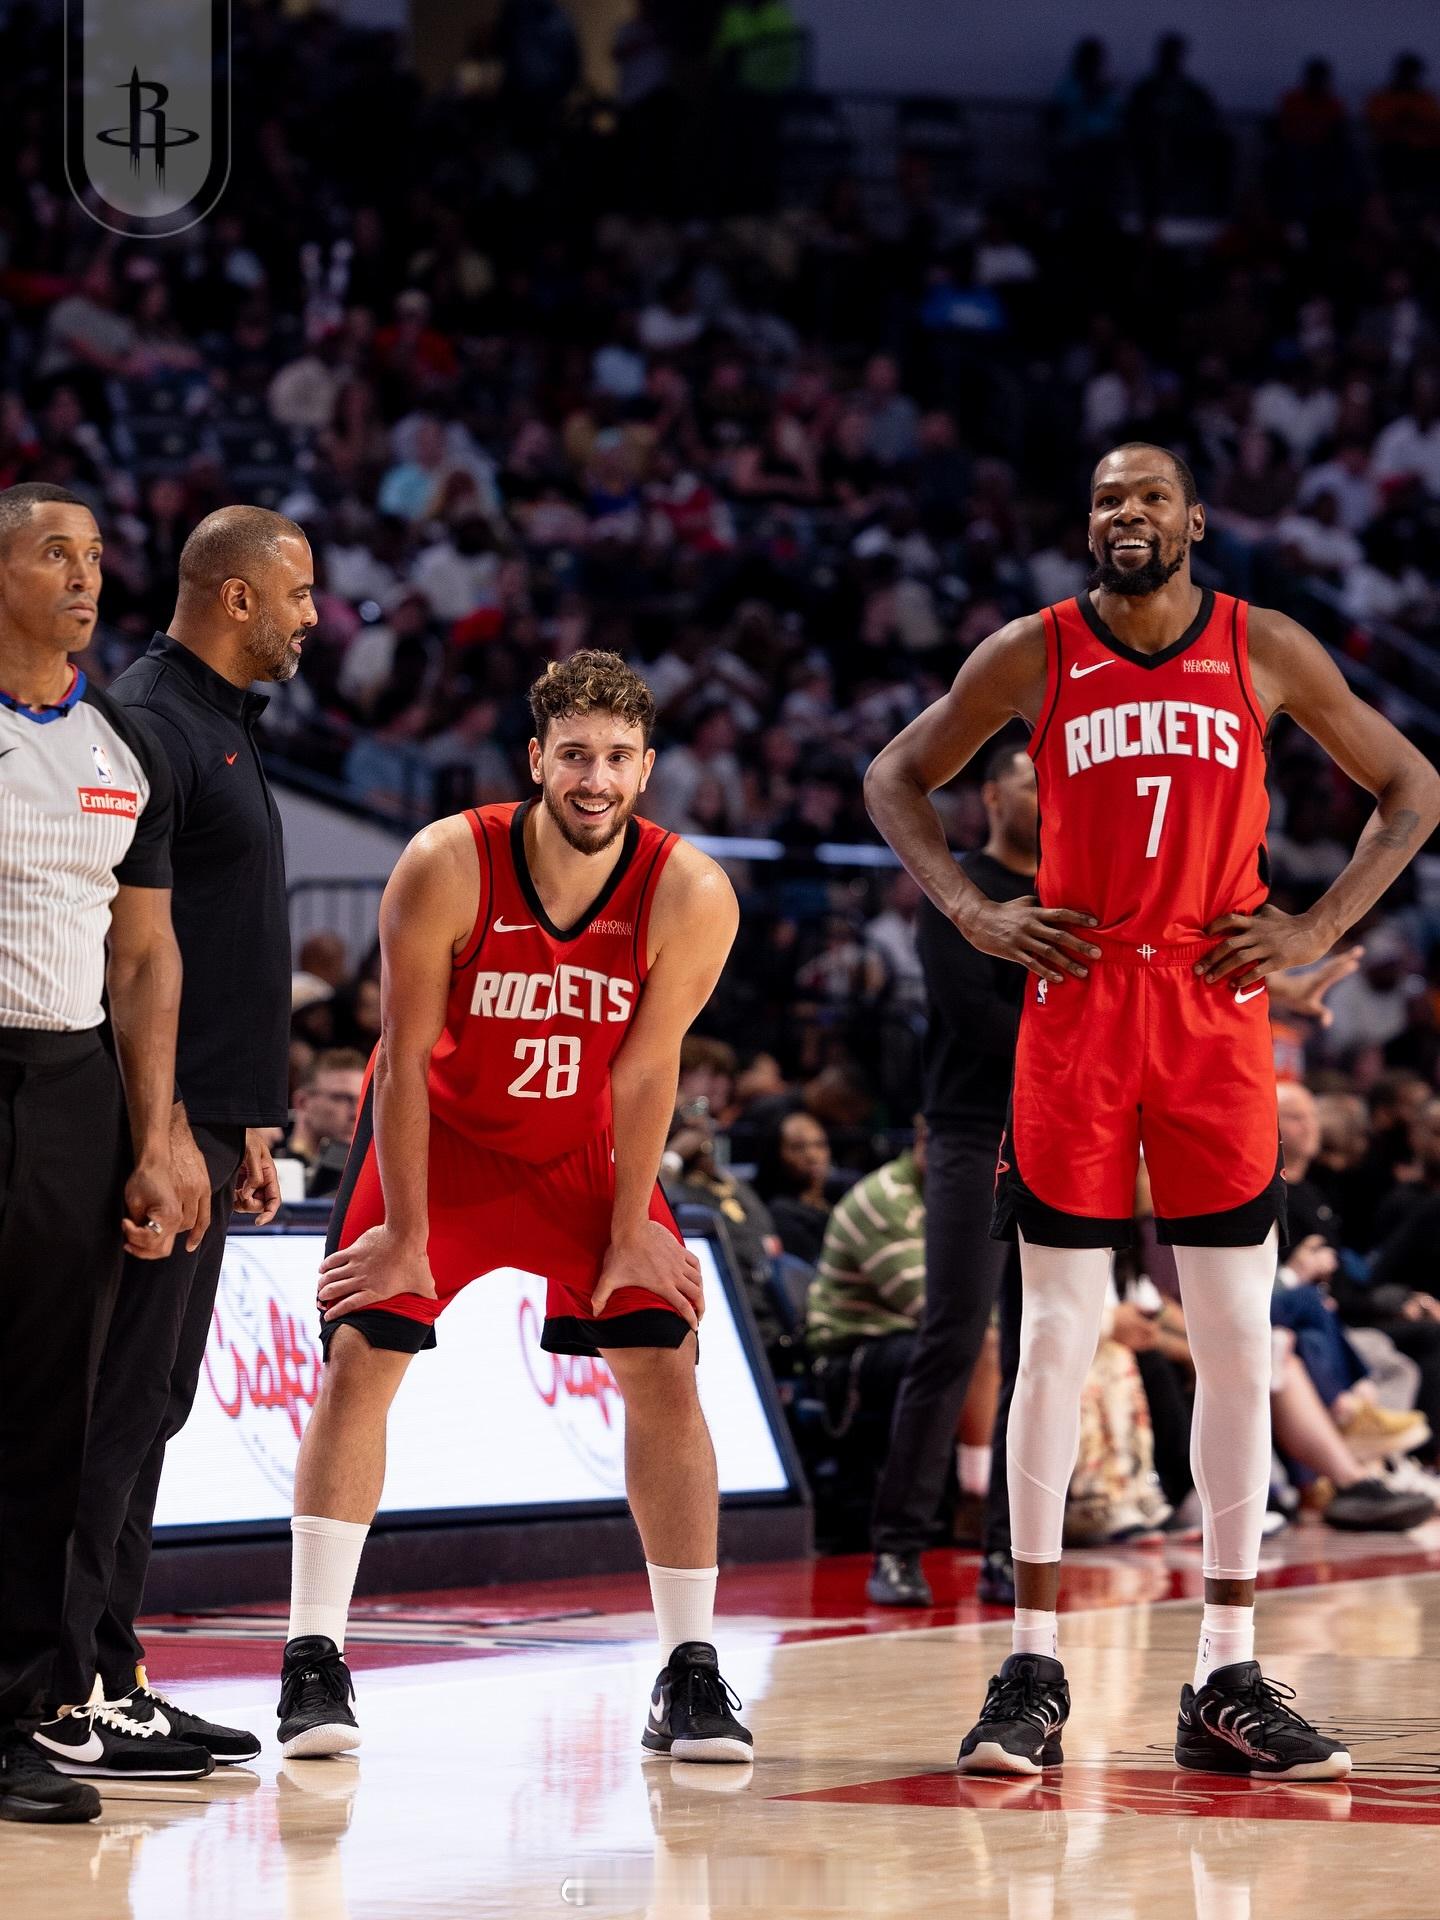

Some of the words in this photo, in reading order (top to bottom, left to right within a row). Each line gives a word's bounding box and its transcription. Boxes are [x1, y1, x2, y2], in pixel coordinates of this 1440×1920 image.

[1183, 659, 1229, 668] MEMORIAL
[1183, 666, 1230, 674] HERMANN
[1064, 700, 1240, 777] ROCKETS
[80, 792, 136, 813] Emirates
[1136, 776, 1172, 858] 7
[588, 926, 632, 936] HERMANN
[507, 1035, 582, 1099] 28
